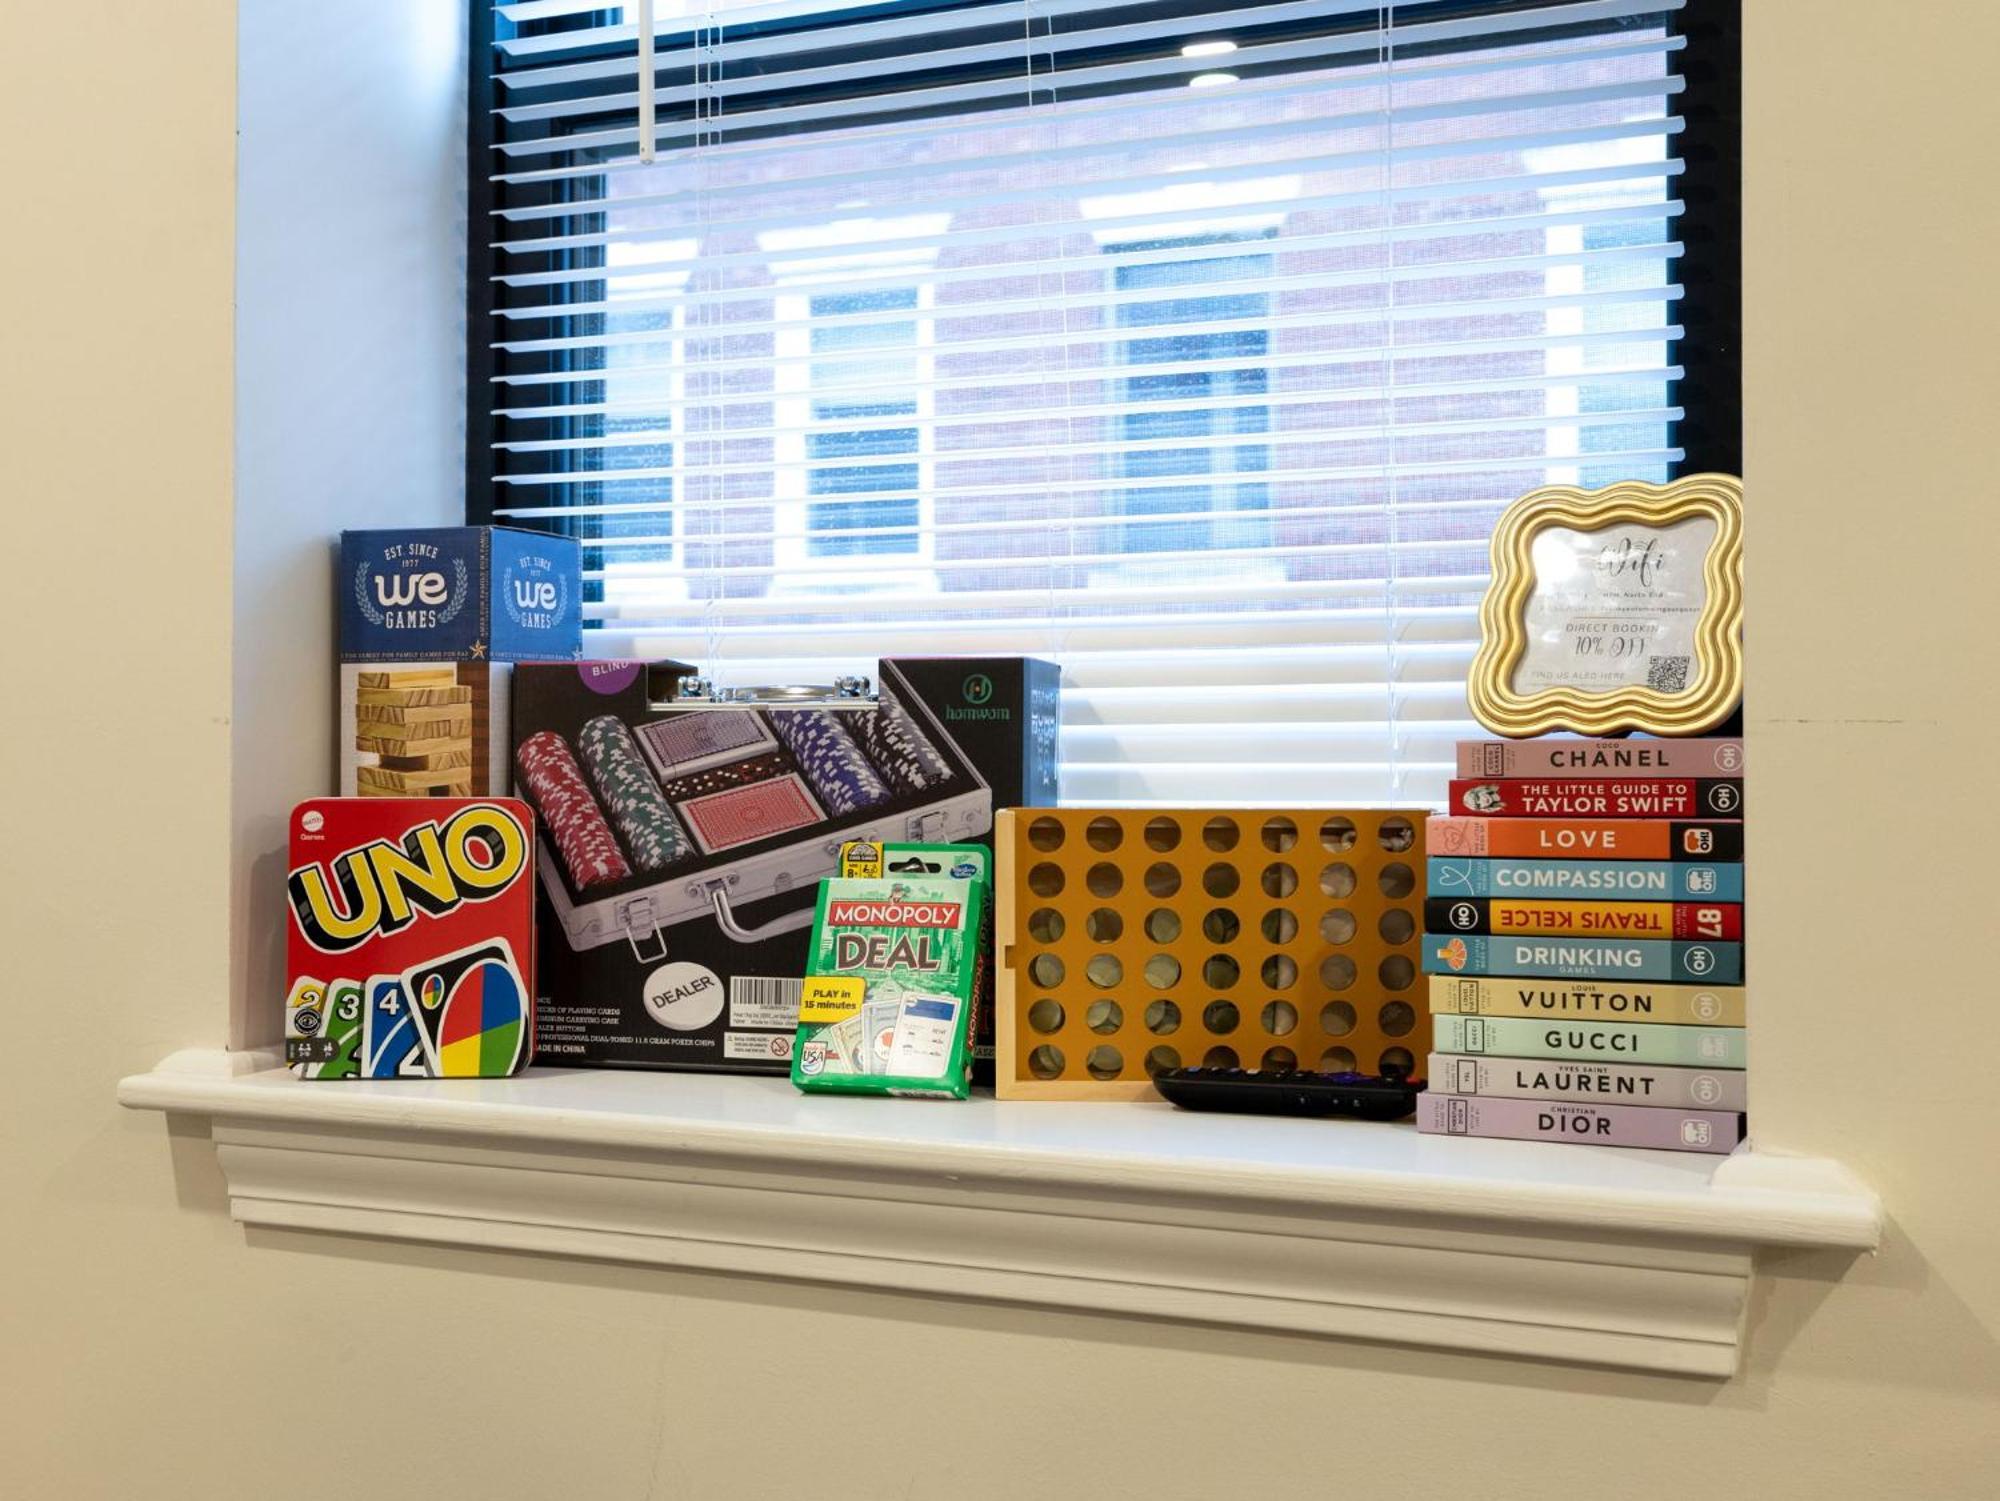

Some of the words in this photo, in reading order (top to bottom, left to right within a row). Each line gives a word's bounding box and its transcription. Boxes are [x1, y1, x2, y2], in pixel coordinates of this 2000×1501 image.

[384, 545, 403, 561] EST
[408, 543, 438, 559] SINCE
[374, 572, 448, 607] we
[514, 580, 557, 610] we
[385, 609, 436, 629] GAMES
[1566, 623, 1608, 633] DIRECT
[1550, 750, 1670, 768] CHANEL
[1723, 748, 1735, 768] OH
[1522, 784, 1552, 795] THE
[1556, 784, 1606, 796] LITTLE
[1611, 784, 1661, 796] GUIDE
[1666, 784, 1687, 795] TO
[1718, 788, 1730, 809] OH
[1522, 797, 1611, 813] TAYLOR
[1616, 797, 1688, 813] SWIFT
[1540, 829, 1616, 849] LOVE
[290, 803, 528, 953] UNO
[1496, 868, 1667, 890] COMPASSION
[834, 905, 958, 925] MONOPOLY
[1458, 906, 1469, 926] OH
[1500, 908, 1577, 929] KELCE
[1580, 911, 1663, 931] TRAVIS
[1697, 909, 1722, 938] 87
[835, 933, 942, 971] DEAL
[1515, 947, 1643, 967] DRINKING
[1693, 950, 1705, 971] OH
[1559, 966, 1597, 975] GAMES
[379, 989, 401, 1016] 4
[652, 975, 715, 1010] DEALER
[813, 989, 839, 999] PLAY
[841, 989, 851, 999] in
[968, 953, 985, 1047] MONOPOLY
[1519, 990, 1653, 1013] VUITTON
[338, 993, 360, 1021] 3
[804, 1001, 815, 1009] 15
[816, 1001, 857, 1010] minutes
[538, 1044, 552, 1052] ADE
[1545, 1030, 1638, 1052] GUCCI
[1583, 1066, 1608, 1074] SAINT
[1516, 1071, 1654, 1095] LAURENT
[1550, 1107, 1597, 1115] CHRISTIAN
[1538, 1114, 1612, 1136] DIOR
